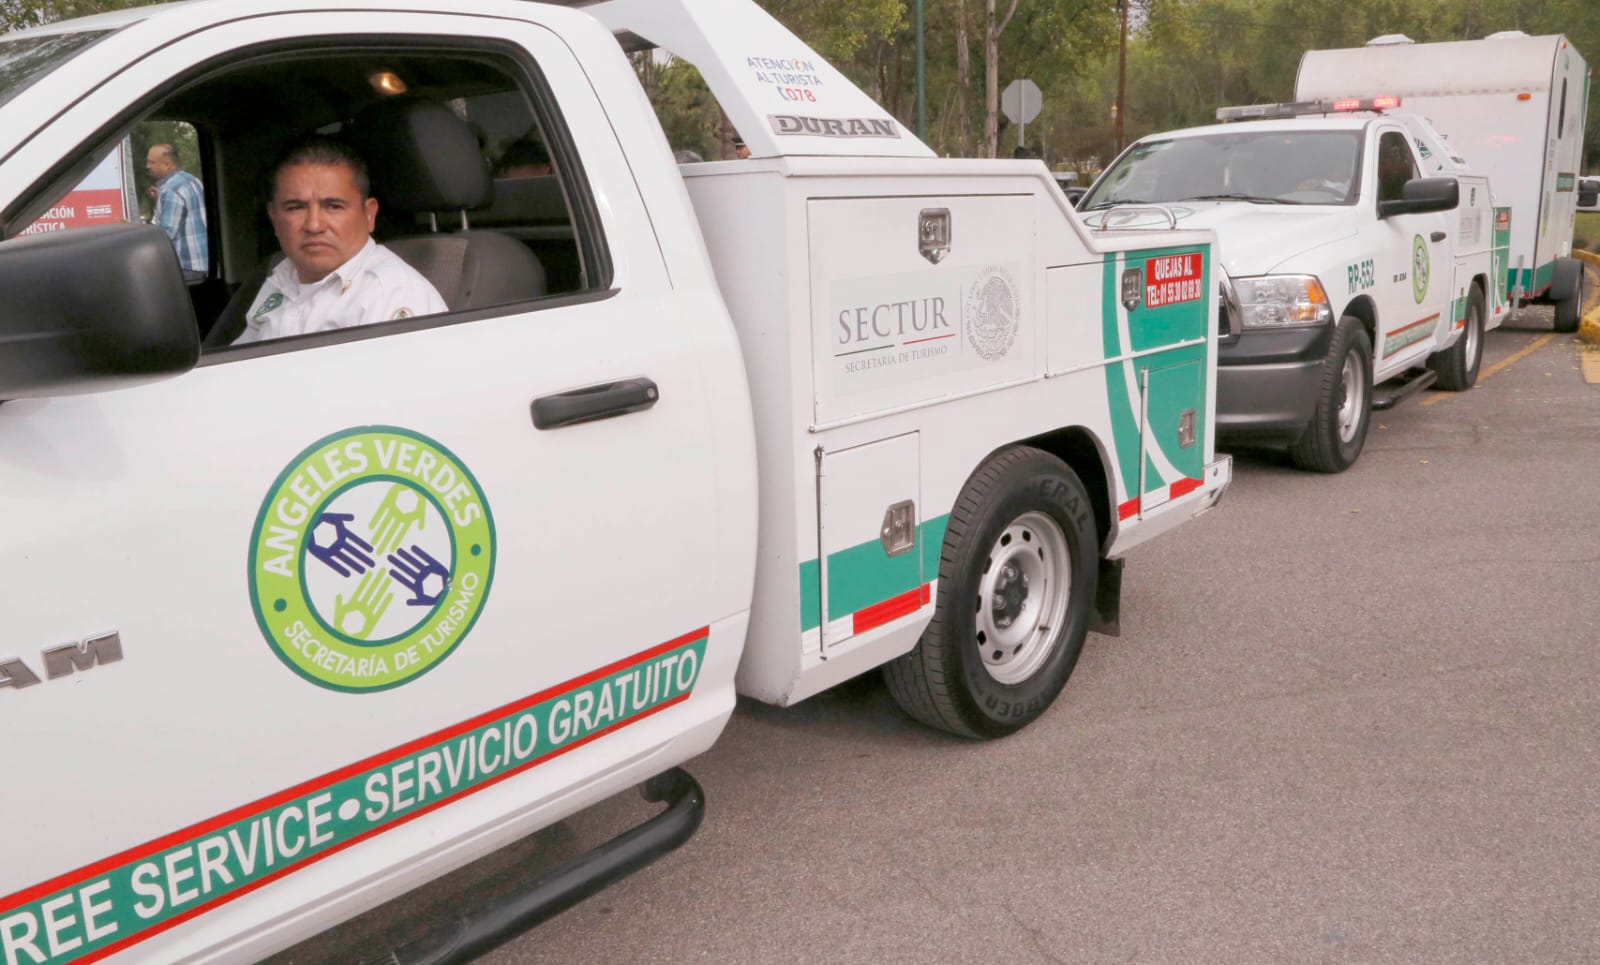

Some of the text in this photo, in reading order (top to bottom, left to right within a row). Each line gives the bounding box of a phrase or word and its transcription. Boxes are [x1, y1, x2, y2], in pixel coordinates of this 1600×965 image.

[770, 73, 823, 86] TURISTA
[774, 115, 897, 137] DURAN
[1155, 255, 1193, 281] QUEJAS AL
[838, 297, 949, 345] SECTUR
[898, 351, 910, 362] DE
[911, 345, 948, 361] TURISMO
[263, 439, 481, 578] ANGELES VERDES
[284, 572, 479, 677] SECRETARÍA DE TURISMO
[548, 649, 697, 744] GRATUITO
